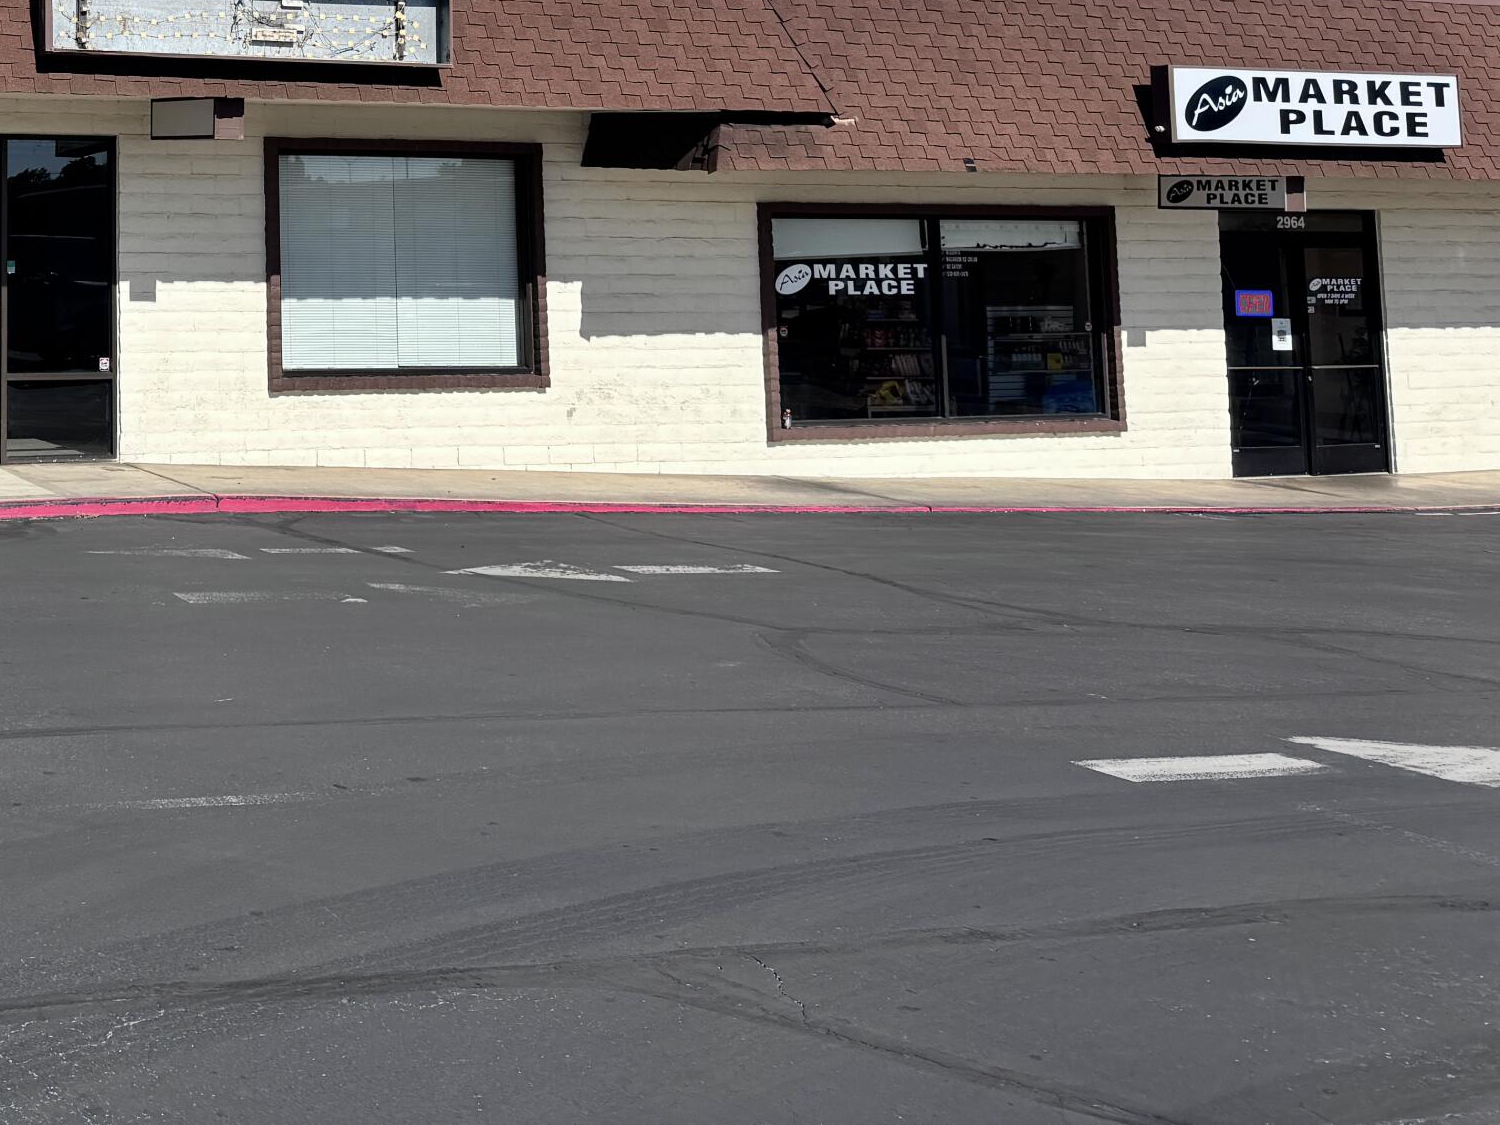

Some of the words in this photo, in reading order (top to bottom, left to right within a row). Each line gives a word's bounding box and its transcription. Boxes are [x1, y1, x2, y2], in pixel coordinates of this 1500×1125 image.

[1192, 85, 1245, 125] Asia
[1252, 77, 1450, 107] MARKET
[1279, 109, 1429, 138] PLACE
[1196, 179, 1279, 192] MARKET
[1206, 193, 1269, 205] PLACE
[1276, 216, 1305, 229] 2964
[813, 264, 928, 279] MARKET
[828, 280, 915, 295] PLACE
